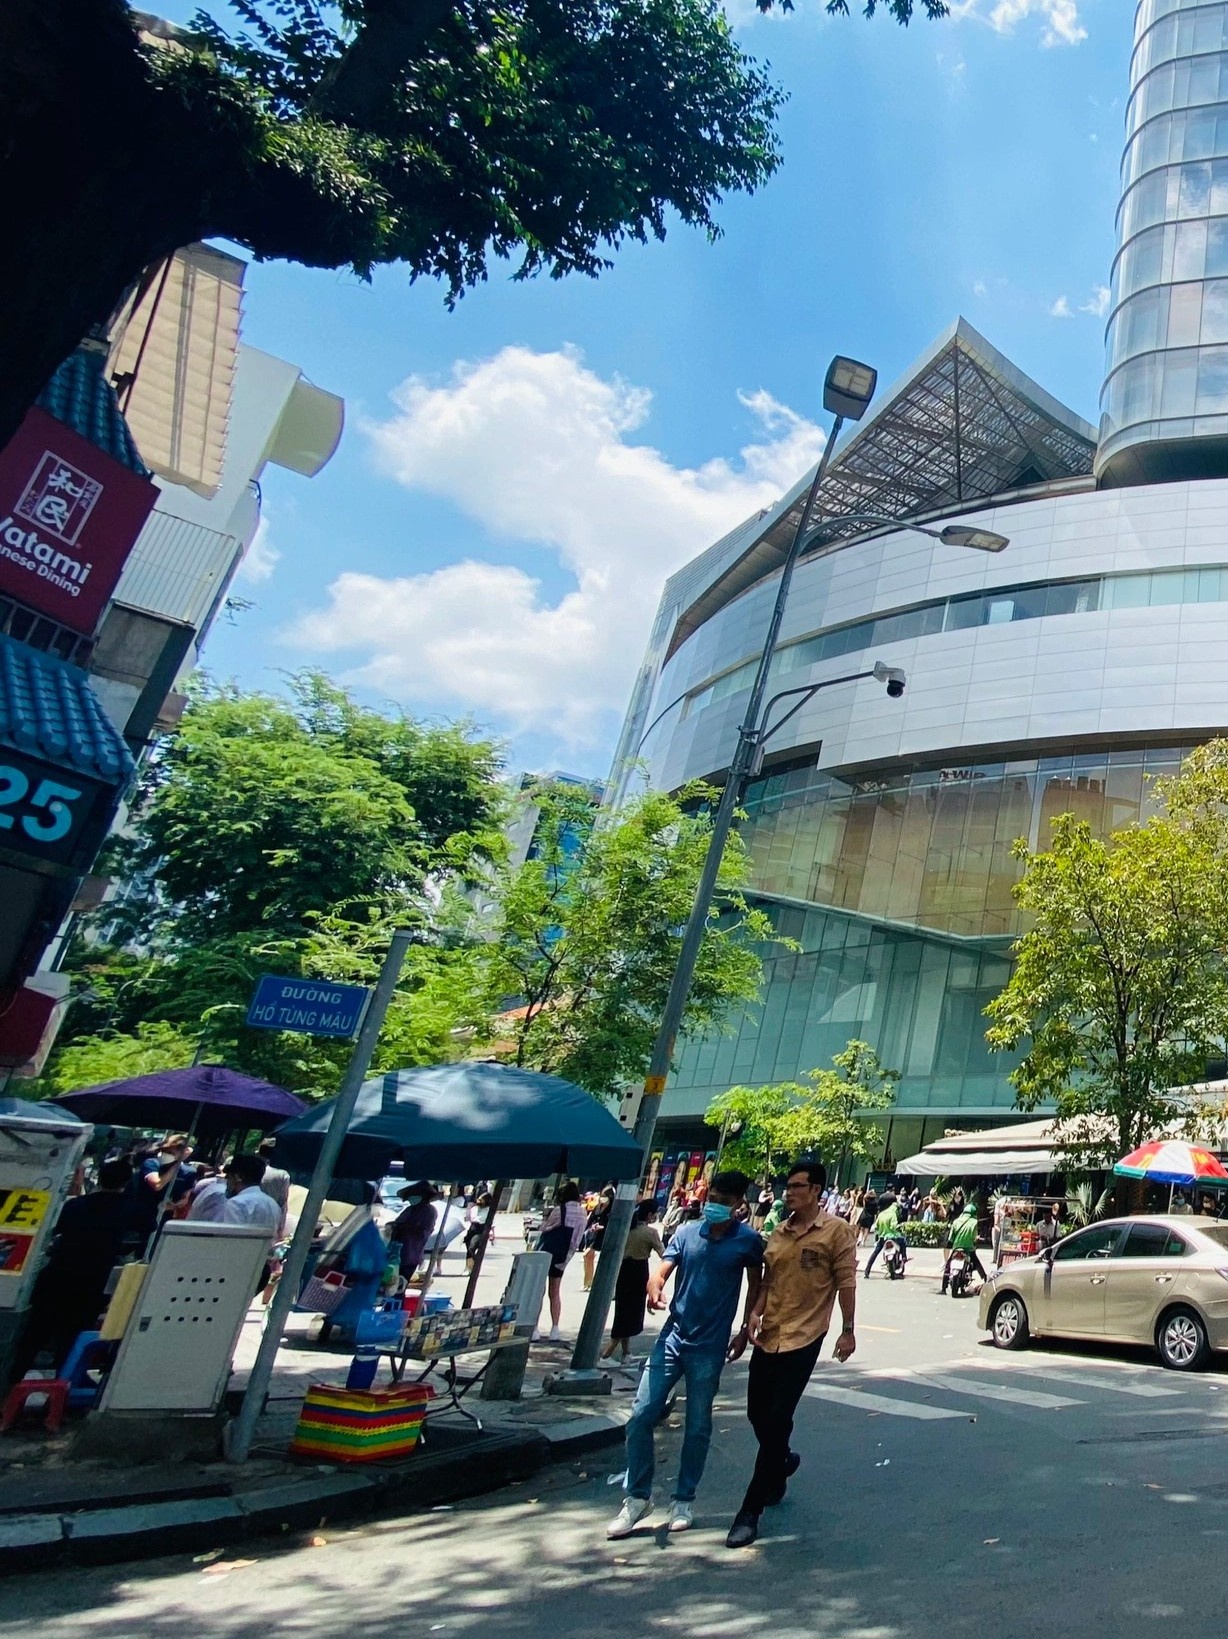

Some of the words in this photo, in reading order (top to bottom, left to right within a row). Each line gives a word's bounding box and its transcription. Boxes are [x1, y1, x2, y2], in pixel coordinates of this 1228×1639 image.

[36, 469, 83, 531] 和民
[0, 517, 93, 585] atami
[37, 564, 81, 597] Dining
[281, 986, 343, 1004] ĐƯỜNG
[253, 1001, 278, 1021] HỒ
[278, 1005, 317, 1027] TÙNG
